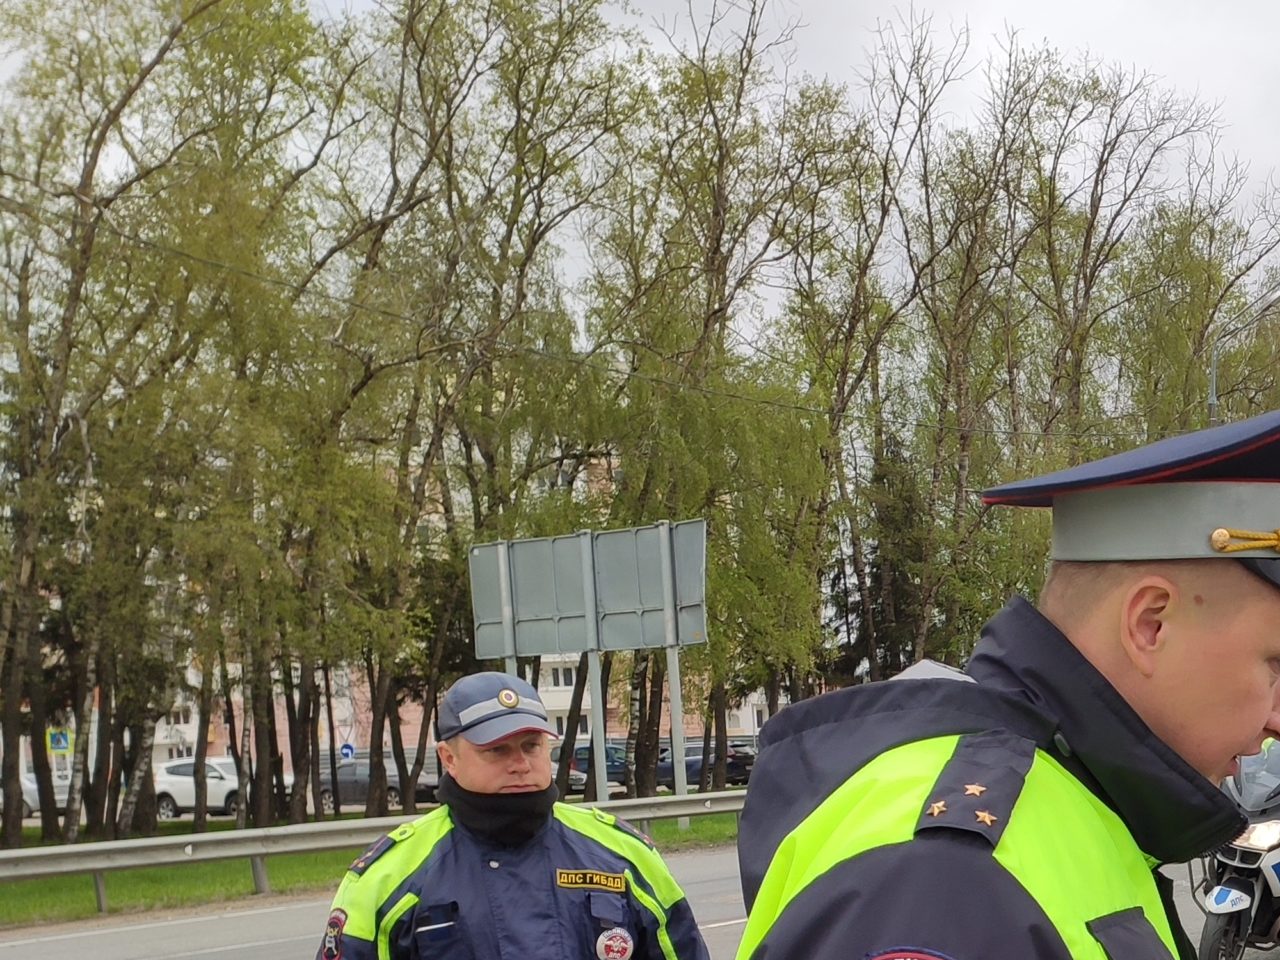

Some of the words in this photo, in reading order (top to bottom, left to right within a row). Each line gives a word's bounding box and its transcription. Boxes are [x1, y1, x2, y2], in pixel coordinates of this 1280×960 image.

[559, 873, 584, 884] ДПС
[586, 873, 622, 889] ГИБДД
[1230, 895, 1244, 908] ДПС
